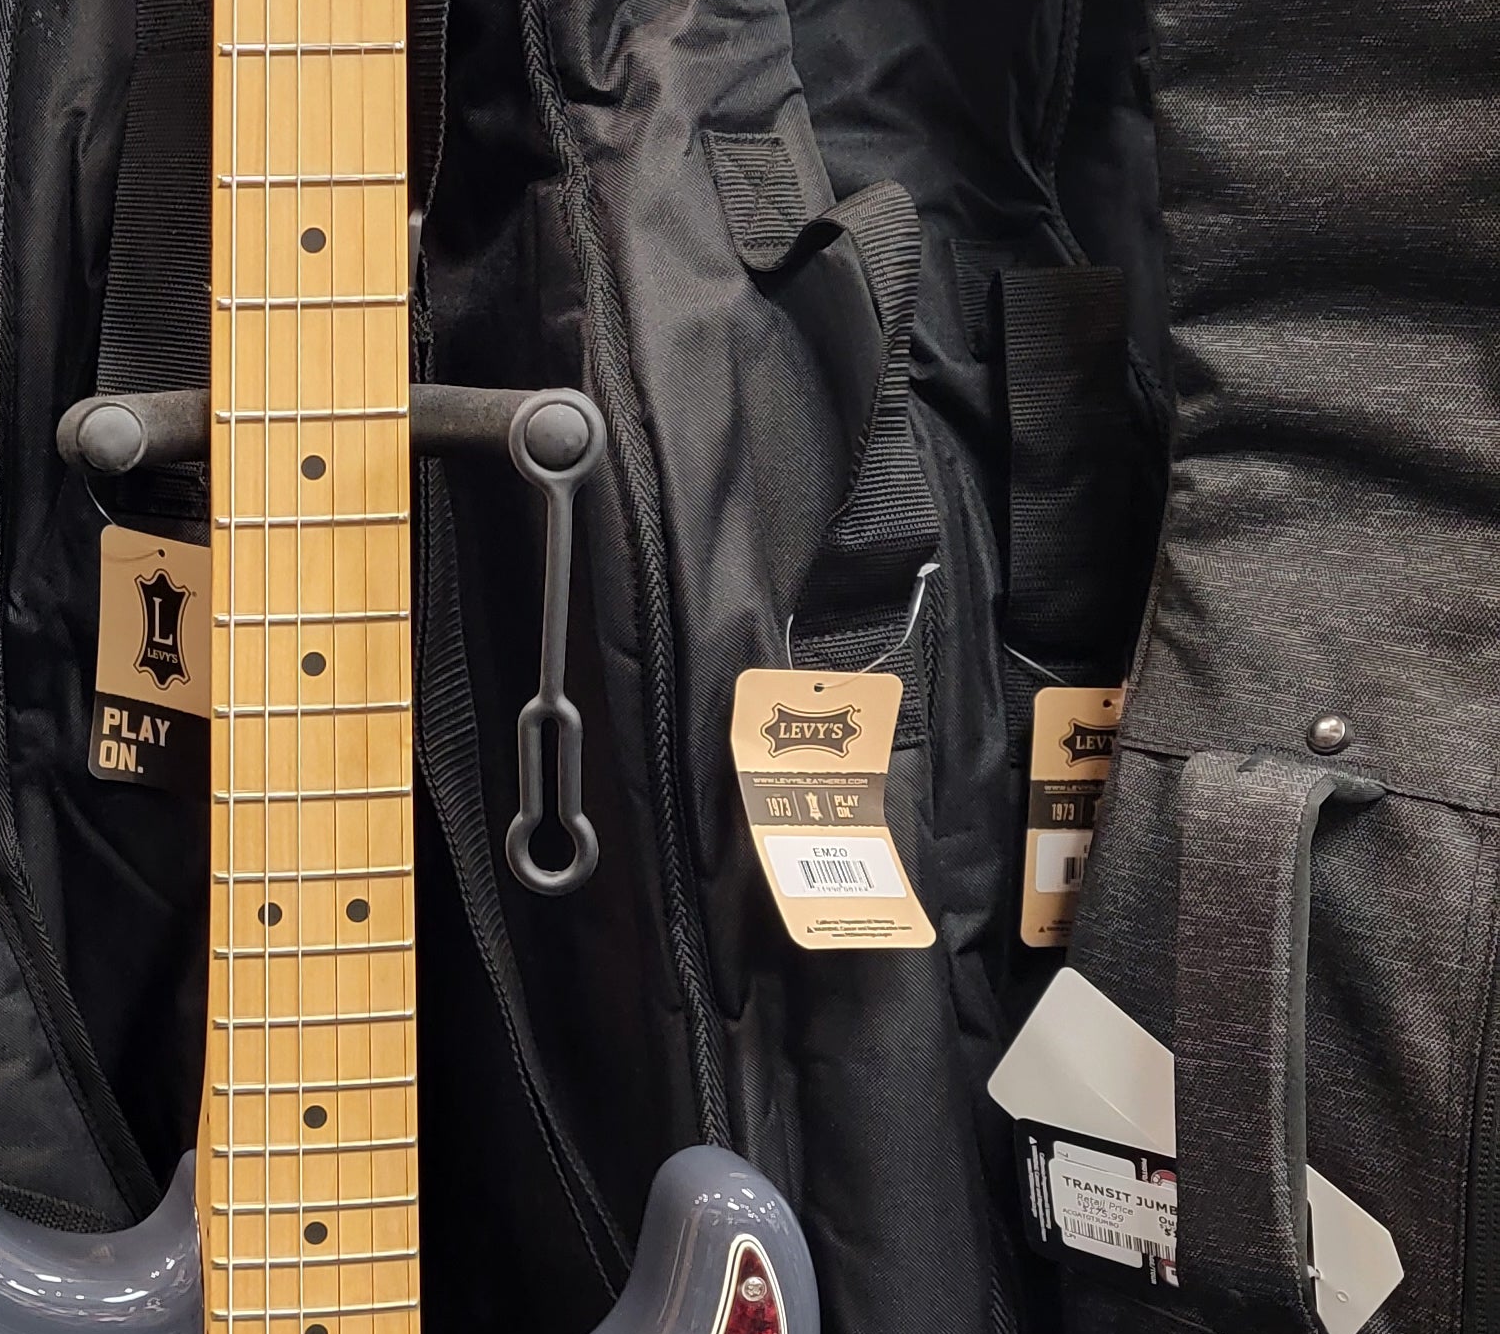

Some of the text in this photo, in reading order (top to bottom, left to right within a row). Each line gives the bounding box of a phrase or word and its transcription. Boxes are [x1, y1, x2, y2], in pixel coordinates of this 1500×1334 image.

[152, 597, 173, 646] L
[102, 706, 171, 747] PLAY
[778, 722, 844, 739] LEVY'S
[98, 739, 144, 774] ON.
[766, 797, 792, 817] 1973
[834, 795, 859, 807] PLAY
[1052, 803, 1075, 821] 1973
[812, 847, 848, 857] EM20
[1062, 1175, 1178, 1216] TRANSIT JUMB
[1077, 1192, 1134, 1216] Retail Price
[1159, 1216, 1175, 1227] Ou
